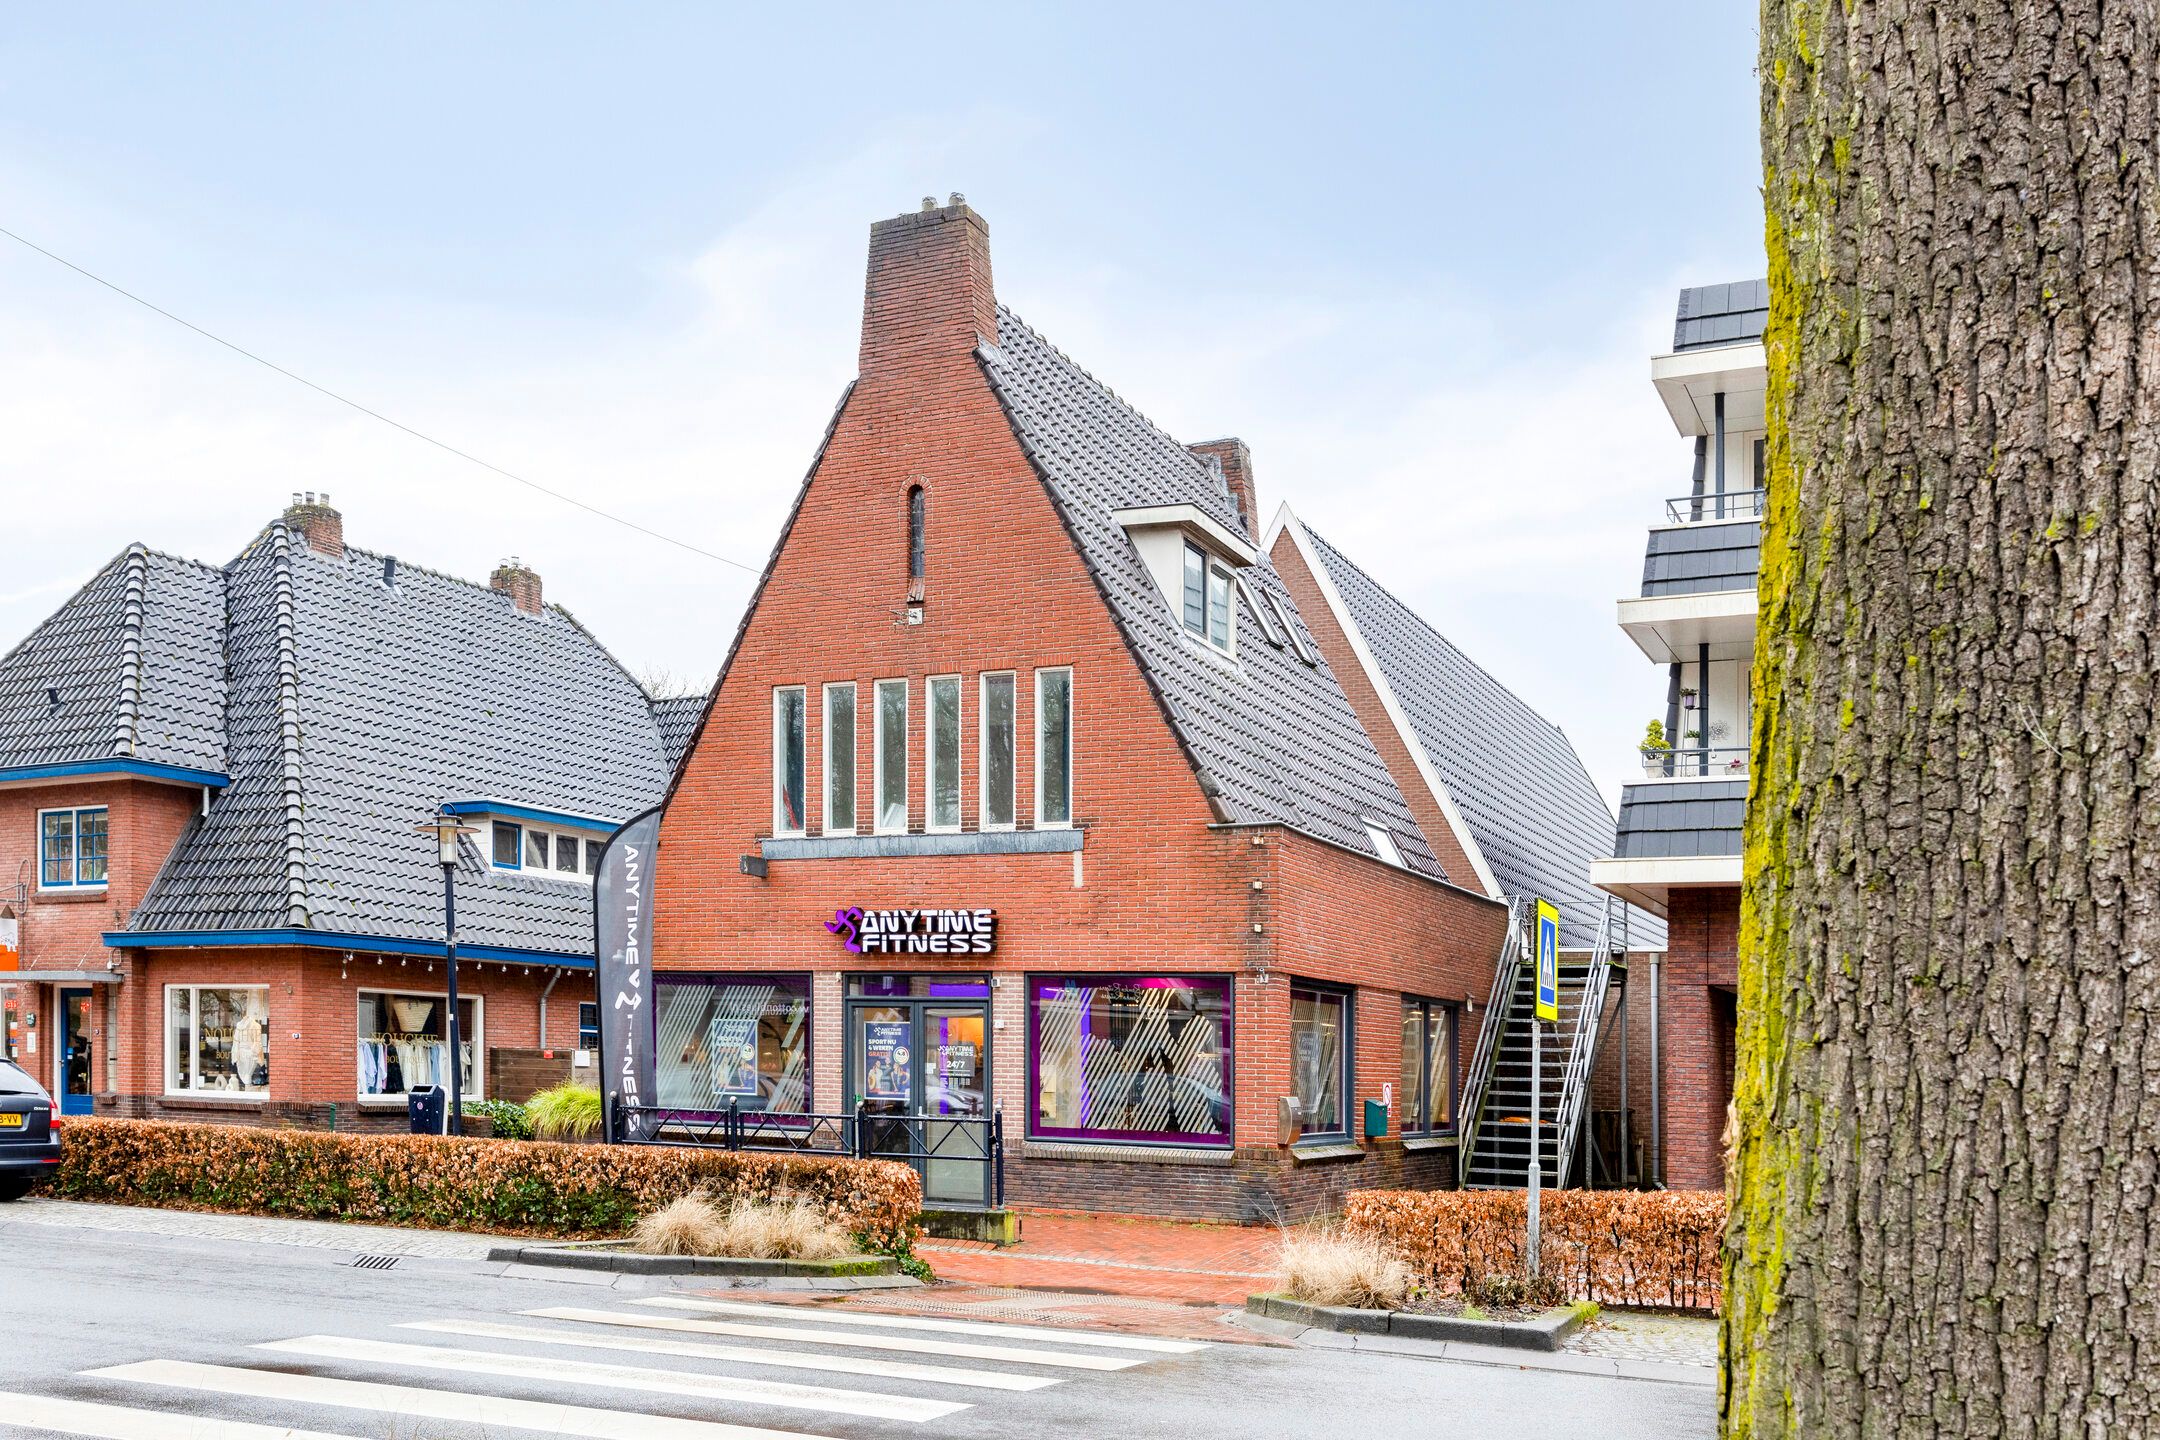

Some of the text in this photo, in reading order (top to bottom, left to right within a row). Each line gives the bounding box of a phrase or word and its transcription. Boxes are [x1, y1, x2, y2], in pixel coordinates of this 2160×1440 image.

[624, 844, 640, 965] ANYTIME
[859, 909, 992, 933] ANYTIME
[862, 934, 992, 953] FITNESS
[946, 1060, 966, 1069] 24/7
